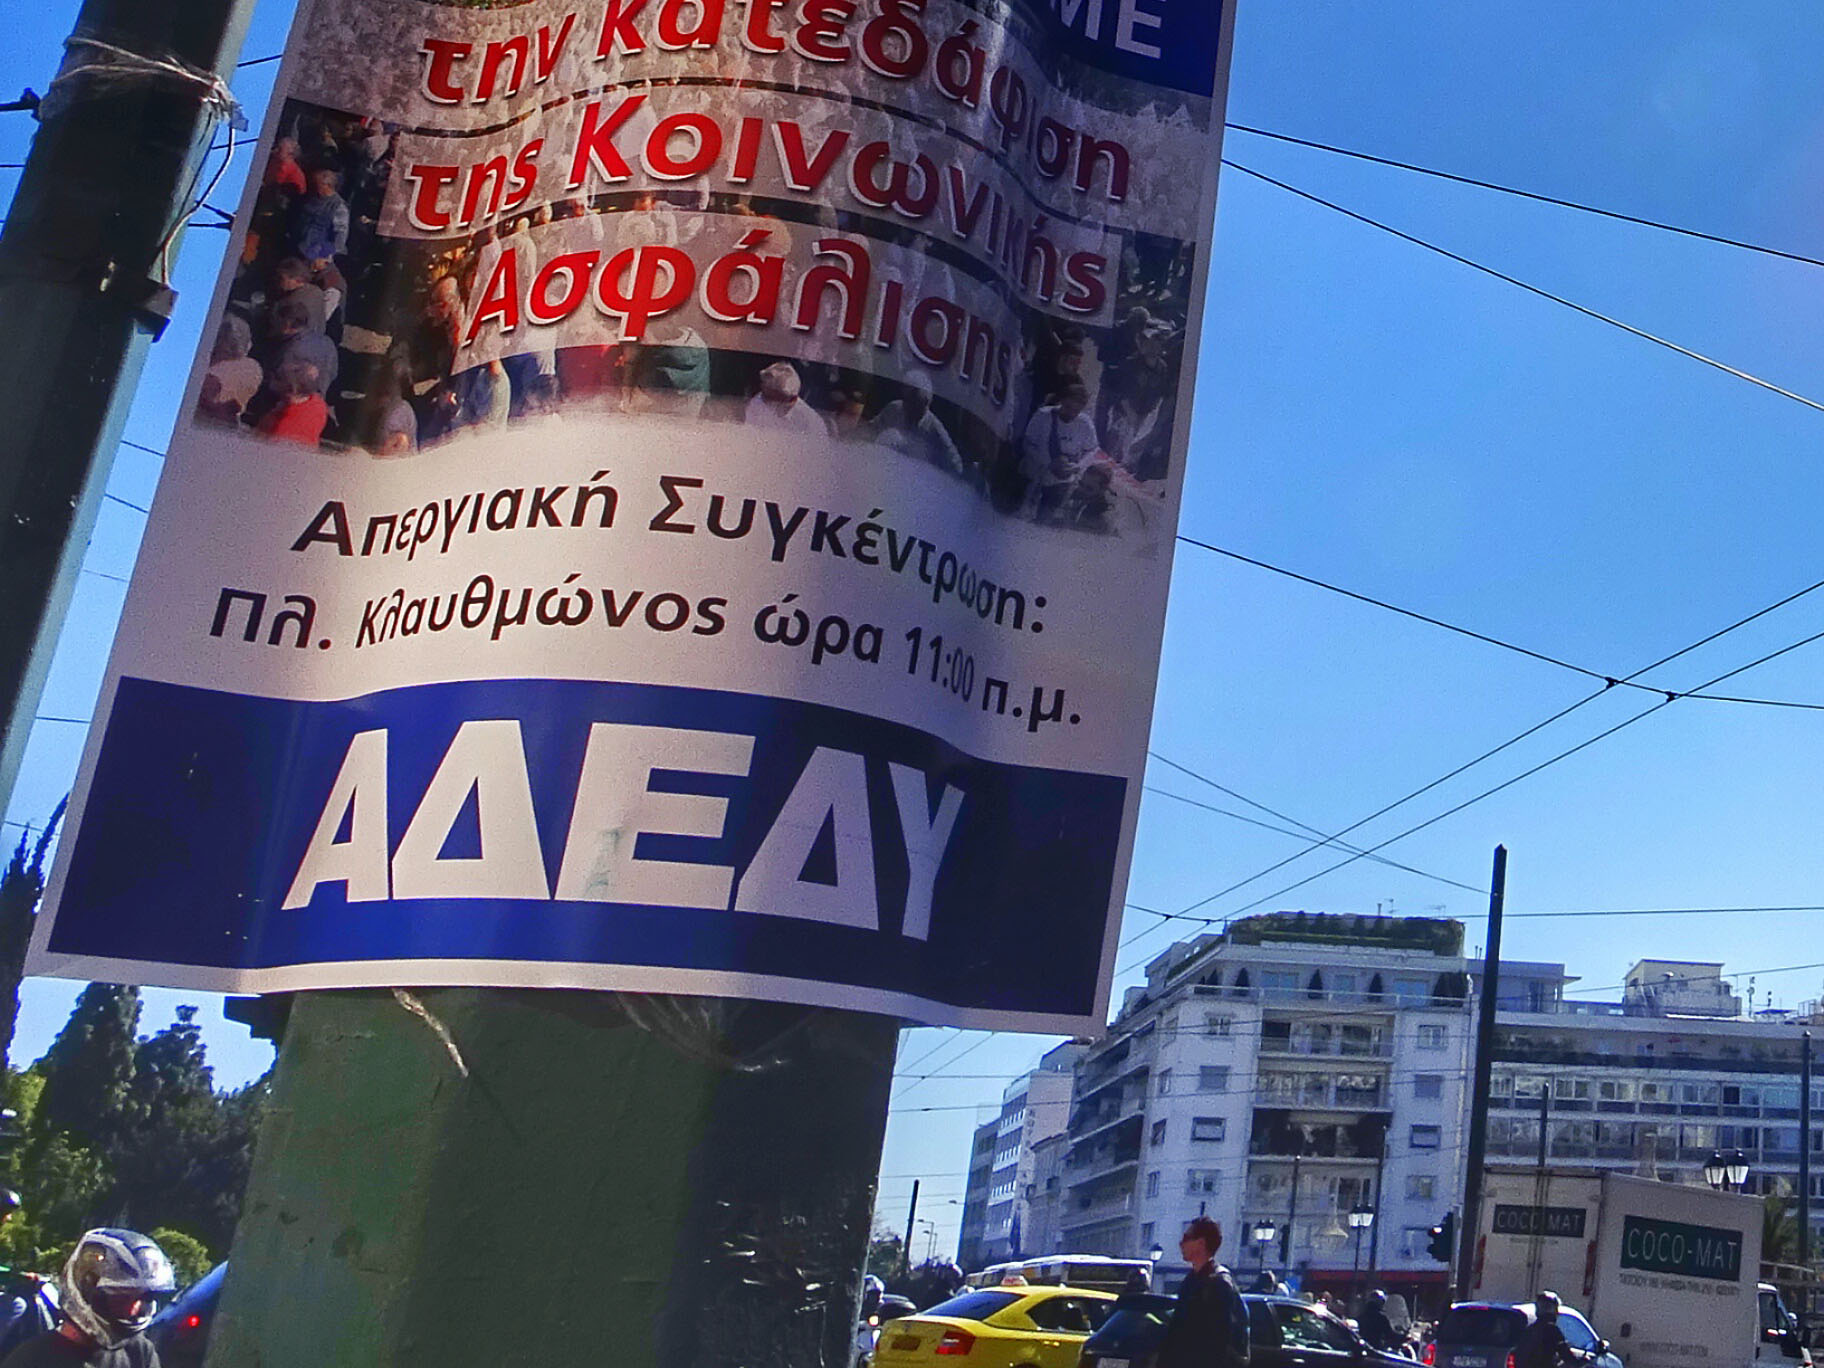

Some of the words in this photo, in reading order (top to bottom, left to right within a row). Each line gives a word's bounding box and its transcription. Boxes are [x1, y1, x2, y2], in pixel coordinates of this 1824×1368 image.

[420, 16, 576, 104] την
[409, 132, 544, 231] της
[565, 96, 1107, 312] Κοινωνικής
[463, 229, 1010, 402] Ασφάλισης
[290, 470, 617, 558] Απεργιακή
[649, 476, 1045, 634] Συγκέντρωση:
[208, 588, 334, 651] Πλ.
[355, 574, 727, 649] Κλαυθμώνος
[754, 596, 883, 666] ώρα
[905, 627, 976, 703] 11:00
[982, 675, 1082, 731] π.μ.
[282, 718, 966, 941] ΑΔΕΔΥ
[1626, 1227, 1738, 1270] COCO-MAT
